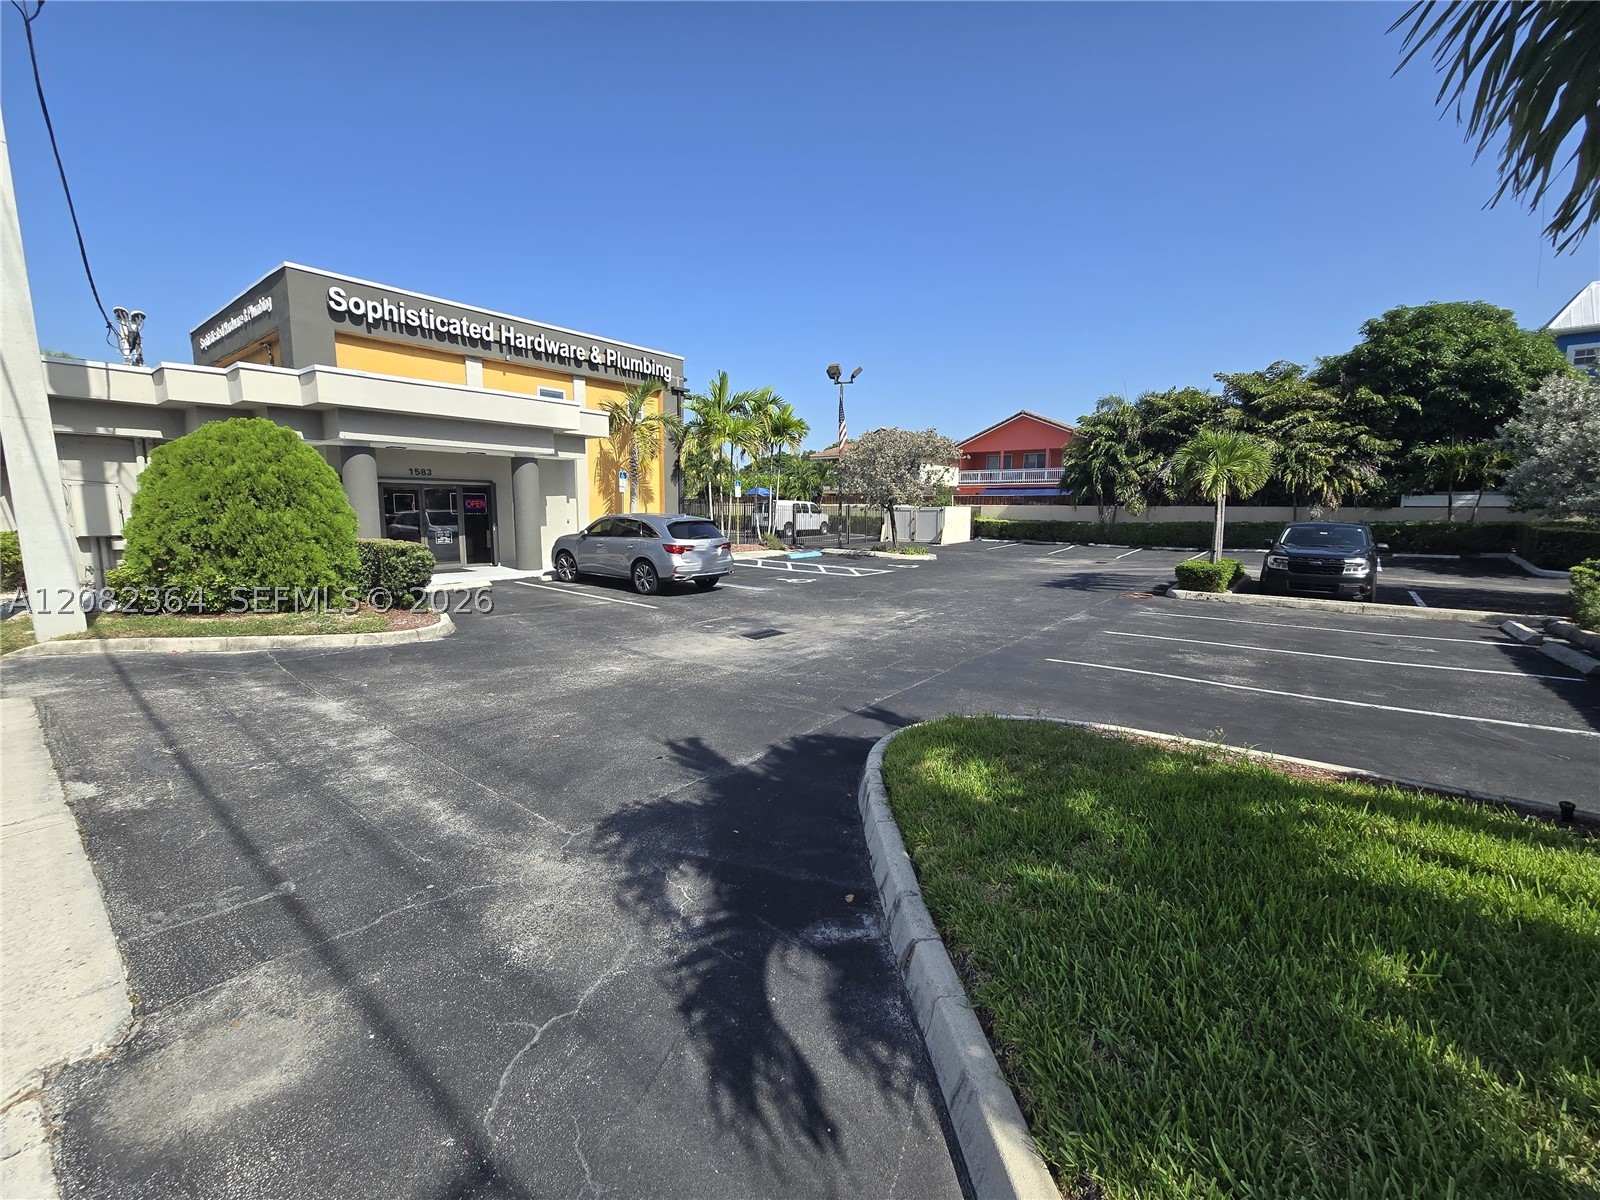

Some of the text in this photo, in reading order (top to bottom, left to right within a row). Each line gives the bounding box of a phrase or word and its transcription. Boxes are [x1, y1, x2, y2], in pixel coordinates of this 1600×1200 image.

[328, 286, 673, 382] Sophisticated Hardware & Plumbing
[408, 468, 432, 476] 1583
[465, 500, 487, 508] OPEN
